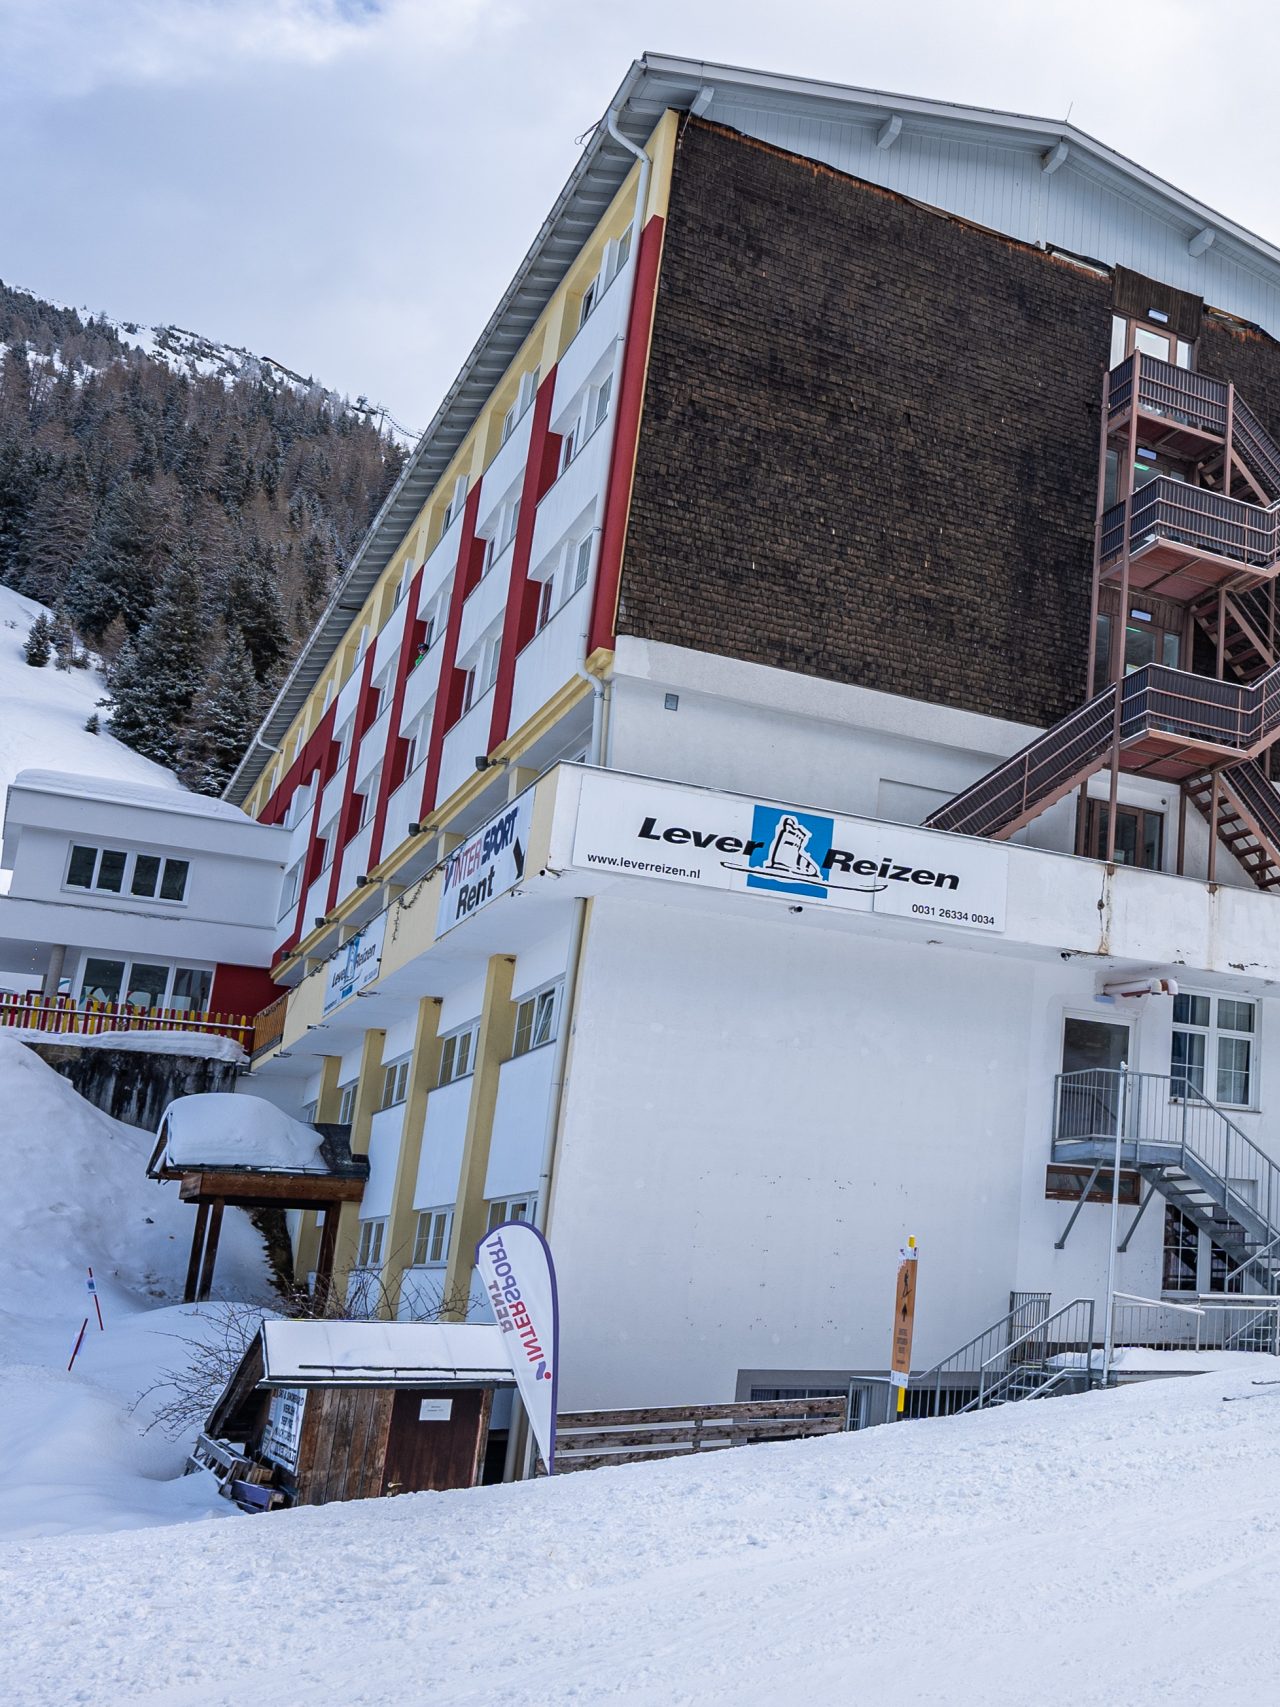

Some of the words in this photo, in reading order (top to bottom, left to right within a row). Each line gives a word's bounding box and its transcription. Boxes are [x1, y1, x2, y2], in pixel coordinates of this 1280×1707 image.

[452, 806, 519, 888] INTERSPORT
[587, 853, 701, 879] www.leverreizen.nl
[638, 816, 766, 856] Lever
[822, 848, 960, 890] Reizen
[455, 865, 495, 920] Rent
[912, 903, 936, 916] 0031
[939, 908, 968, 921] 26334
[972, 913, 995, 925] 0034
